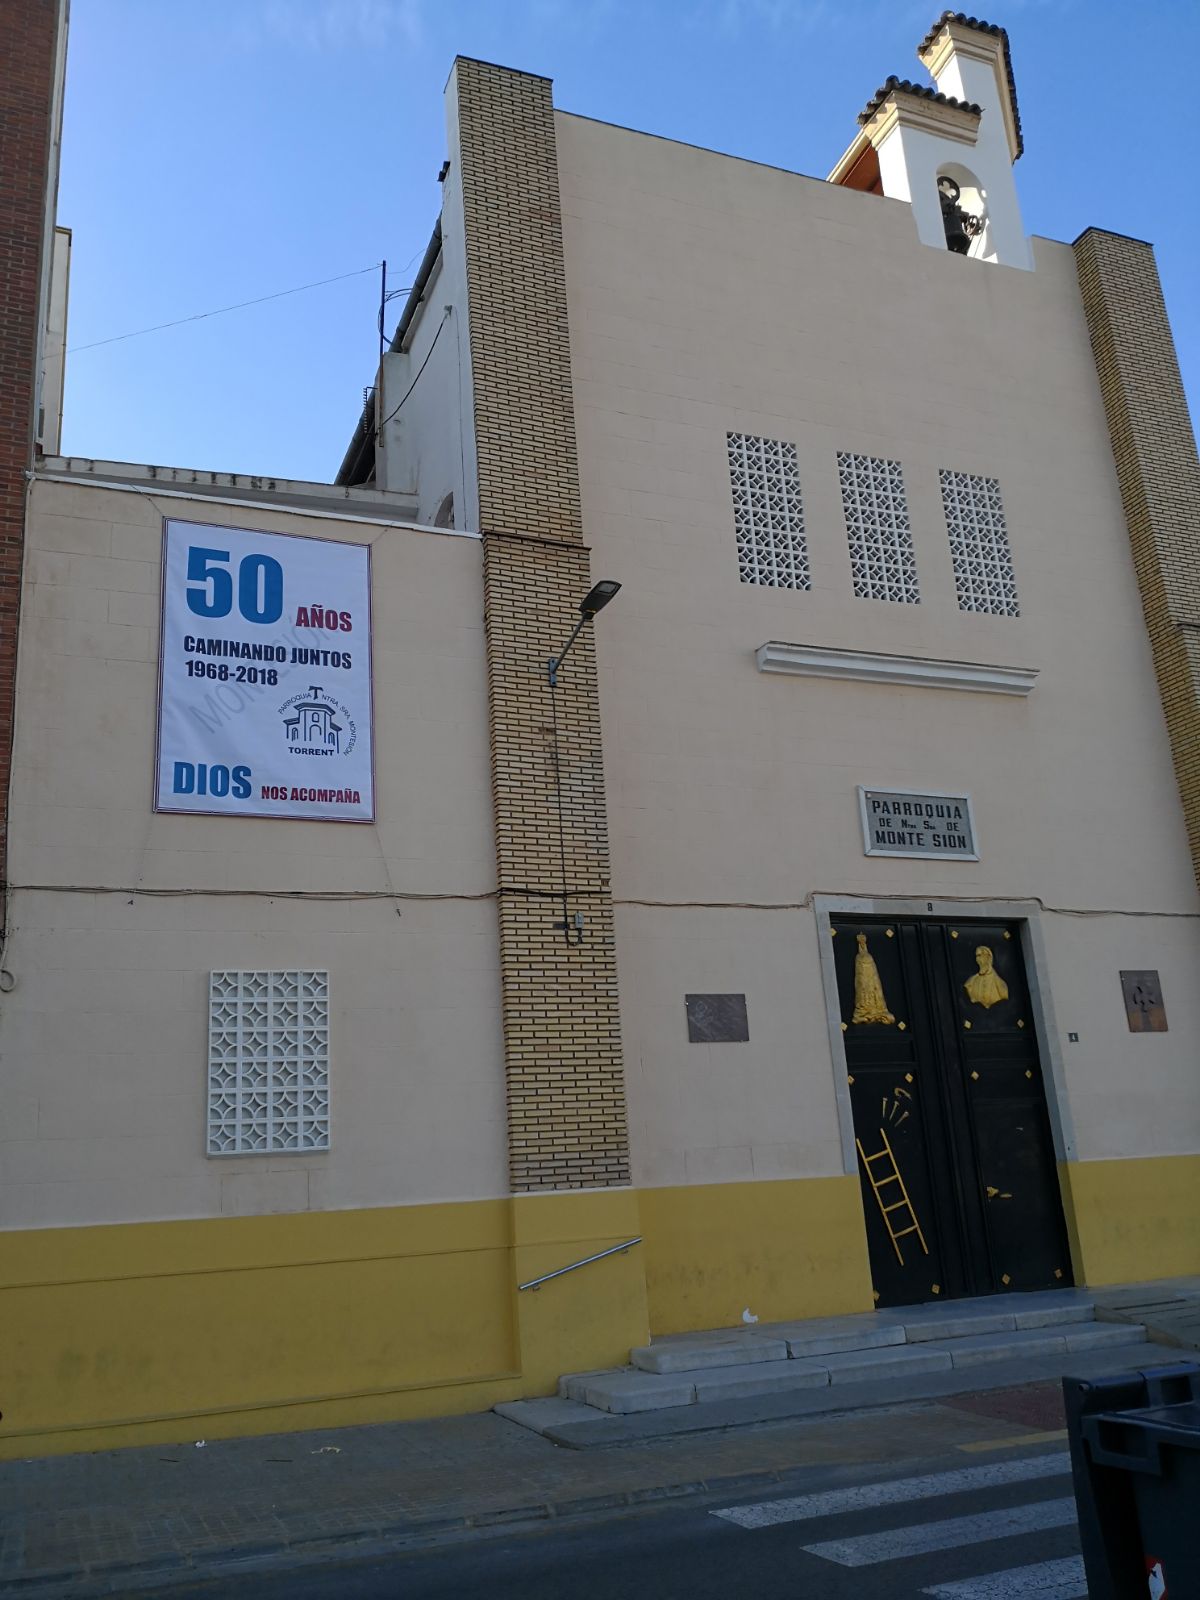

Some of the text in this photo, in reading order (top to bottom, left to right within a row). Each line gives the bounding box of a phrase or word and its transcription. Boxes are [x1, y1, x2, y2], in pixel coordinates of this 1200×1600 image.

[186, 546, 352, 632] 50 AÑOS
[184, 635, 352, 669] CAMINANDO JUNTOS
[185, 660, 278, 686] 1968-2018
[278, 692, 312, 715] PARROQUIA
[288, 747, 334, 756] TORRENT
[173, 761, 361, 804] DIOS NOS ACOMPAÑA
[872, 800, 962, 819] PARROQUIA
[879, 818, 892, 828] DE
[946, 822, 960, 831] DE
[875, 831, 967, 848] MONTE SION
